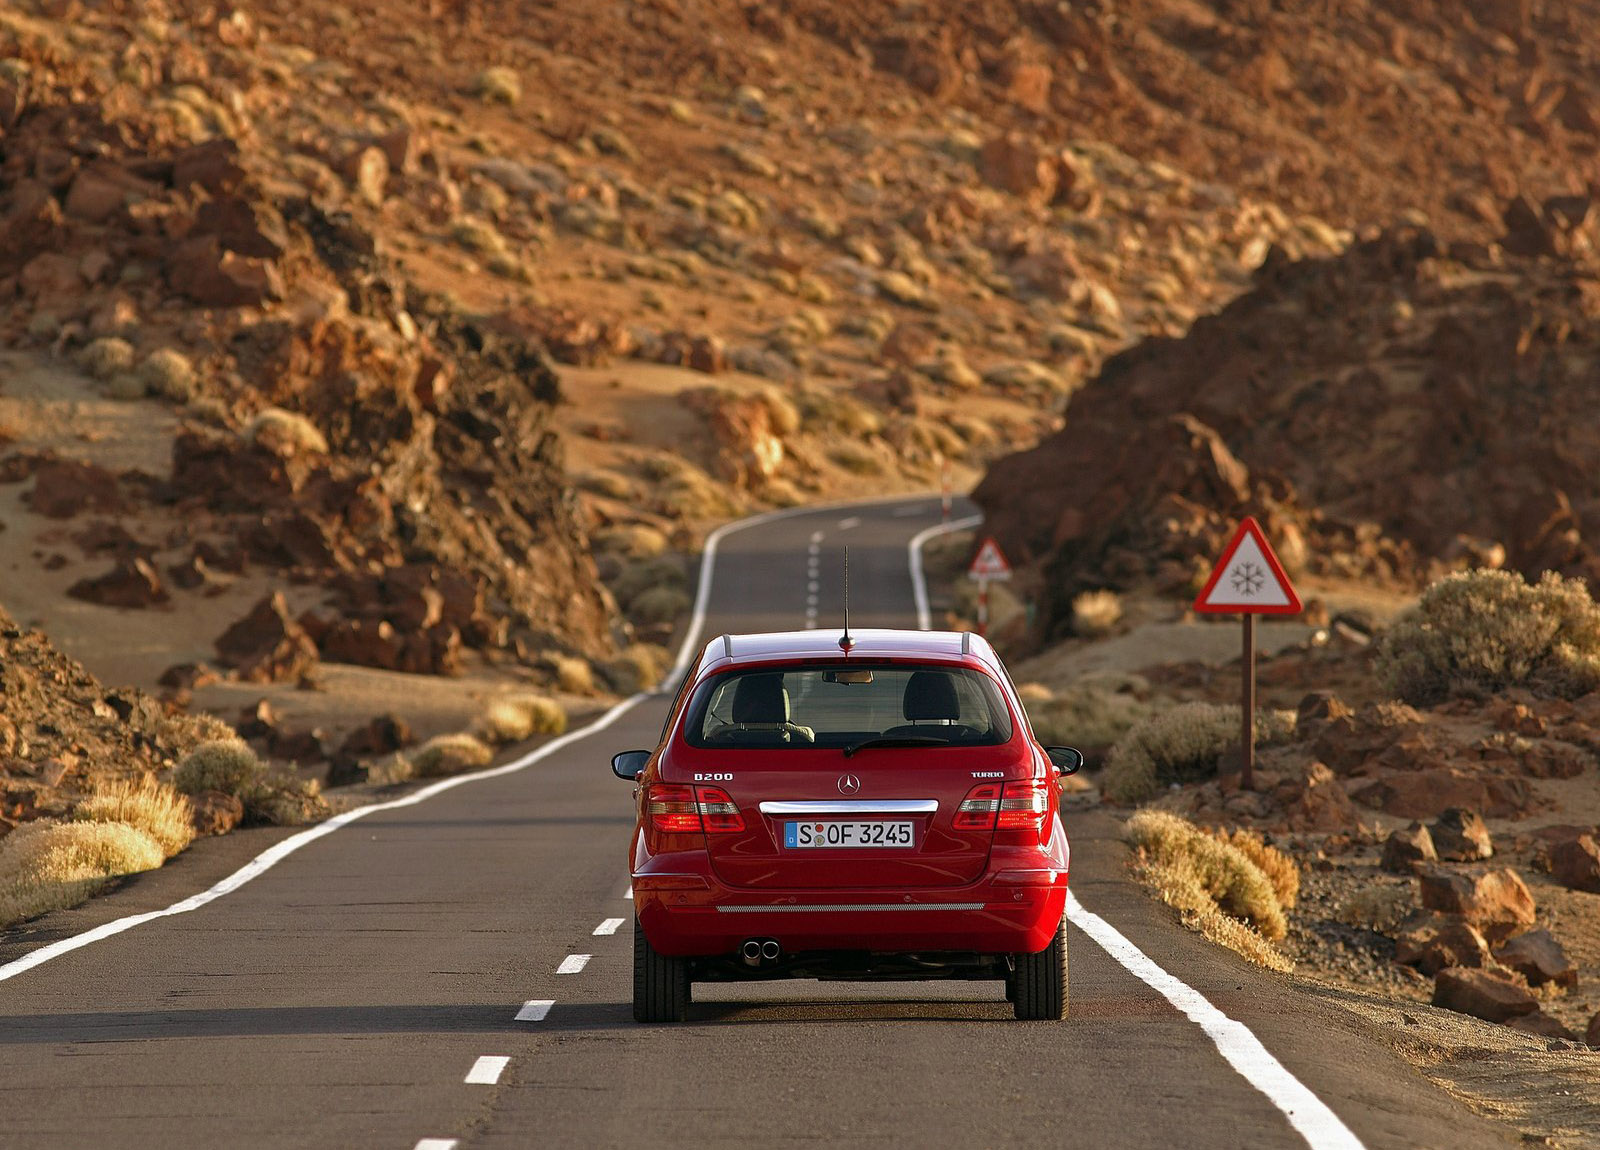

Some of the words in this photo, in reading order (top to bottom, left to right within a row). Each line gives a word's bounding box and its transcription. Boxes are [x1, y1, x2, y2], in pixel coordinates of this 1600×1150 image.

[694, 773, 734, 781] B200
[800, 824, 812, 844] S
[827, 824, 854, 844] OF
[860, 824, 911, 844] 3245
